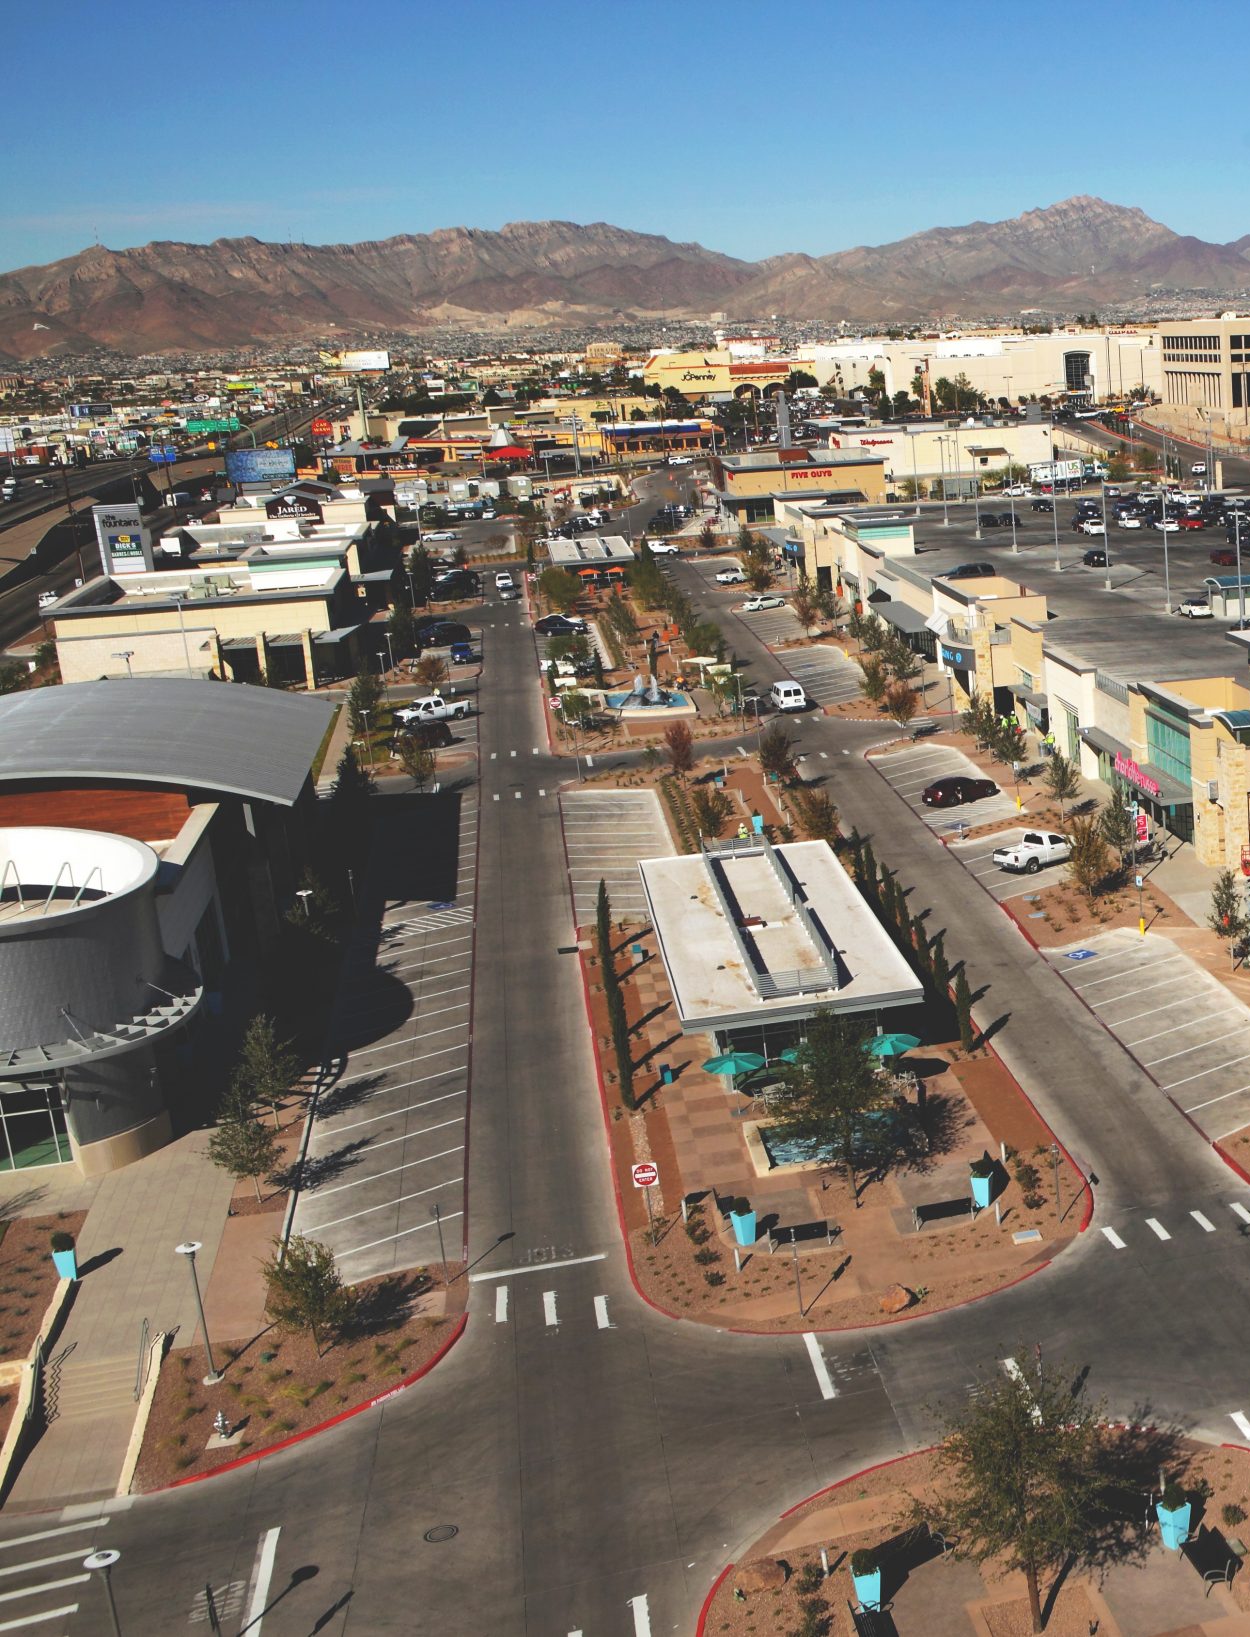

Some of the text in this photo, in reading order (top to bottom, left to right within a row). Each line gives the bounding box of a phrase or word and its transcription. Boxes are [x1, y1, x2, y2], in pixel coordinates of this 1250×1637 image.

[681, 373, 716, 382] JCPenney
[811, 470, 832, 478] GUYS
[102, 518, 140, 528] fountains
